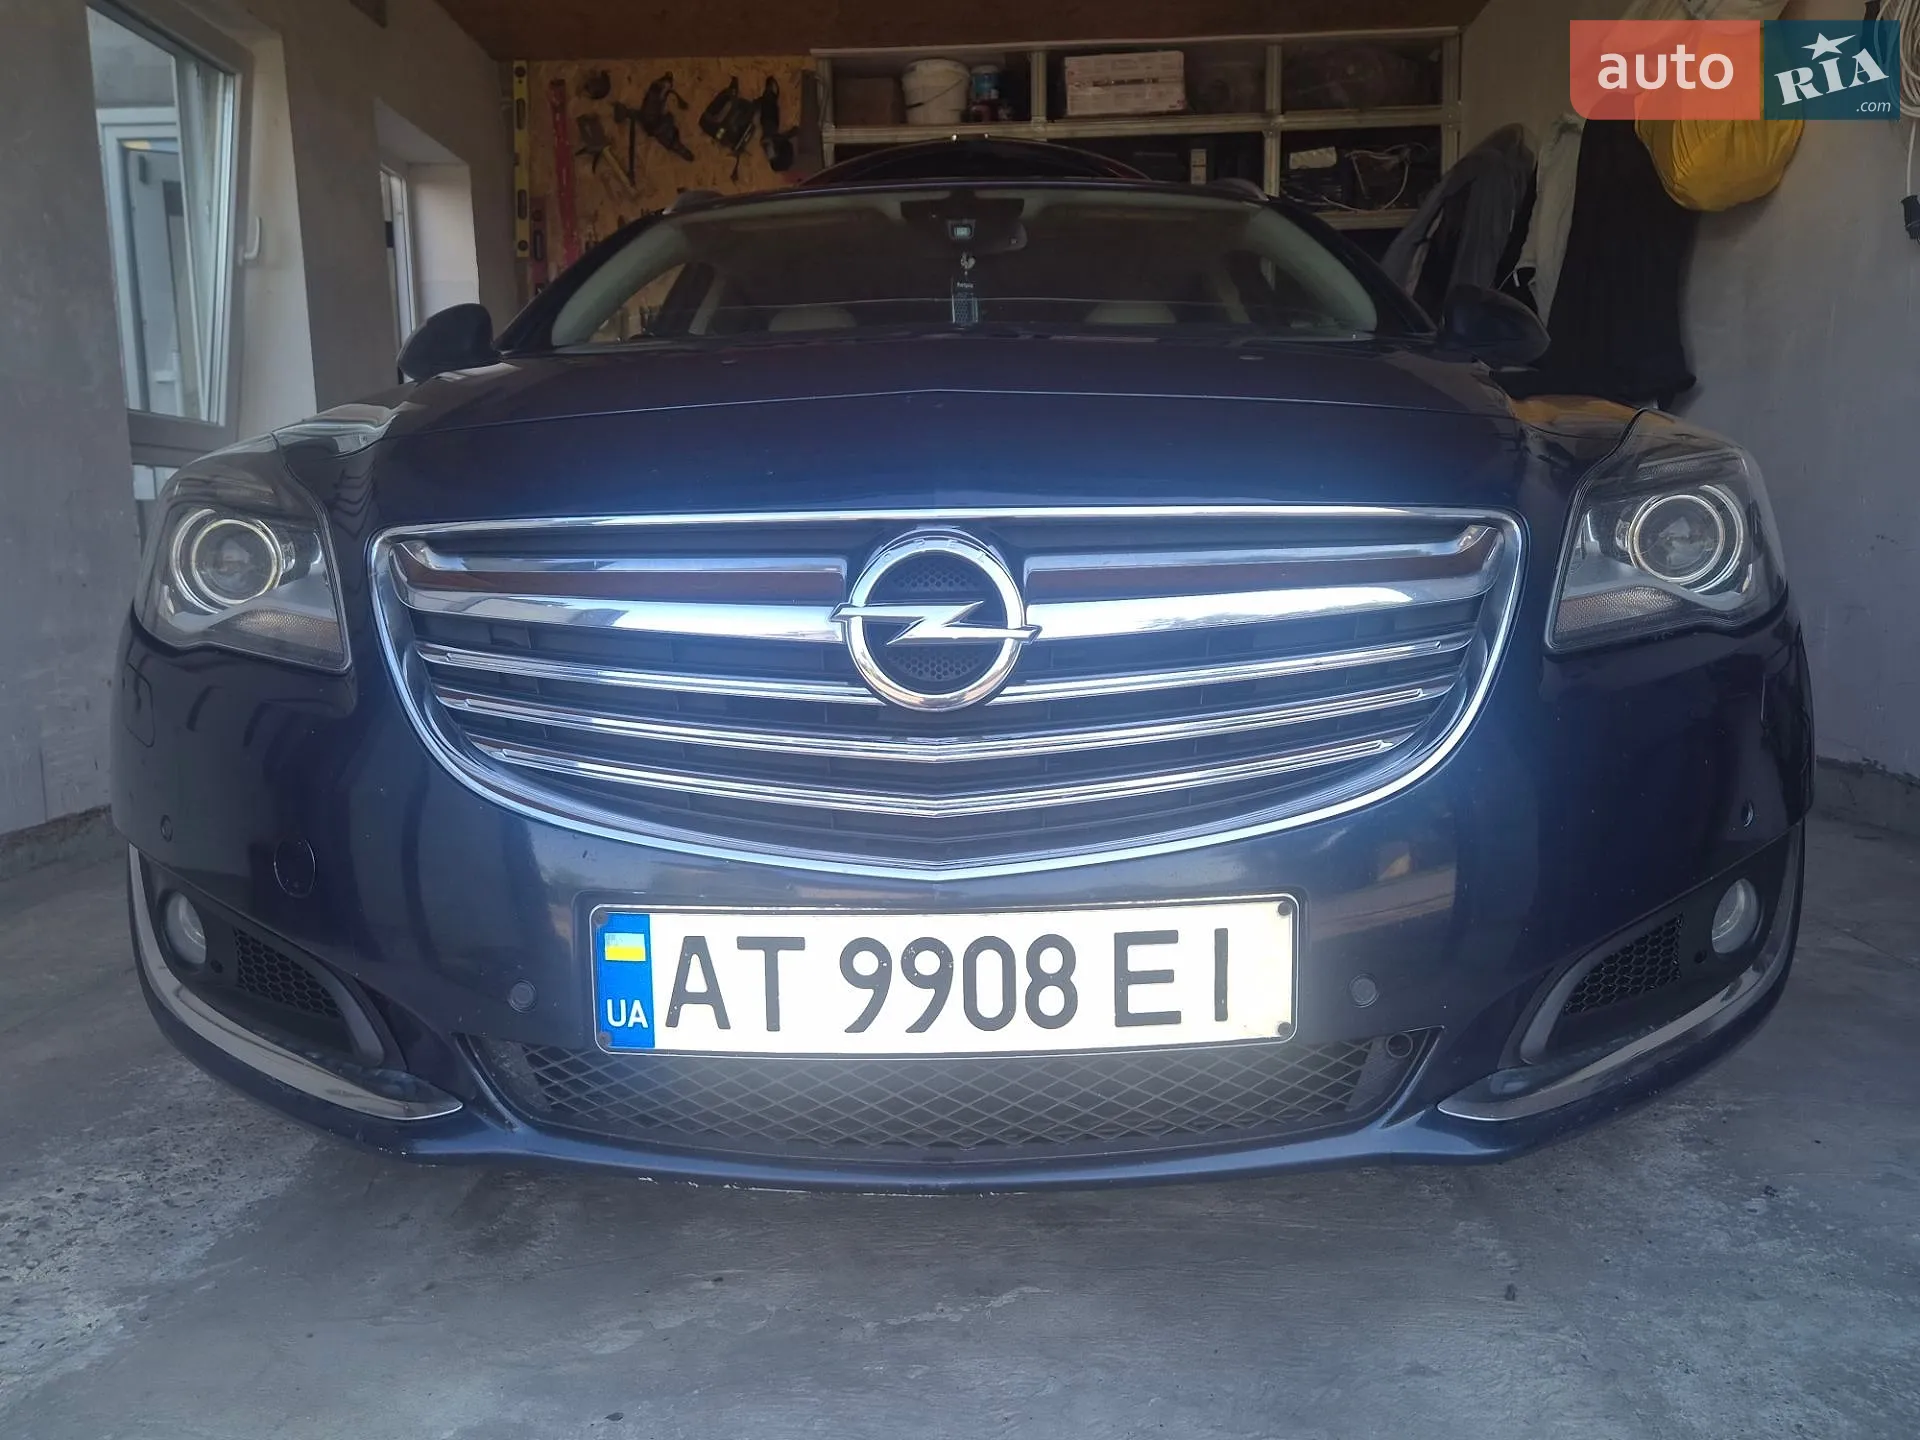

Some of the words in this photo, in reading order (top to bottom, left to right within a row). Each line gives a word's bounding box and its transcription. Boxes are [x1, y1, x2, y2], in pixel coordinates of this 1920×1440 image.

[606, 998, 649, 1028] UA
[665, 935, 806, 1032] AT
[839, 933, 1079, 1034] 9908
[1113, 927, 1229, 1028] EI
